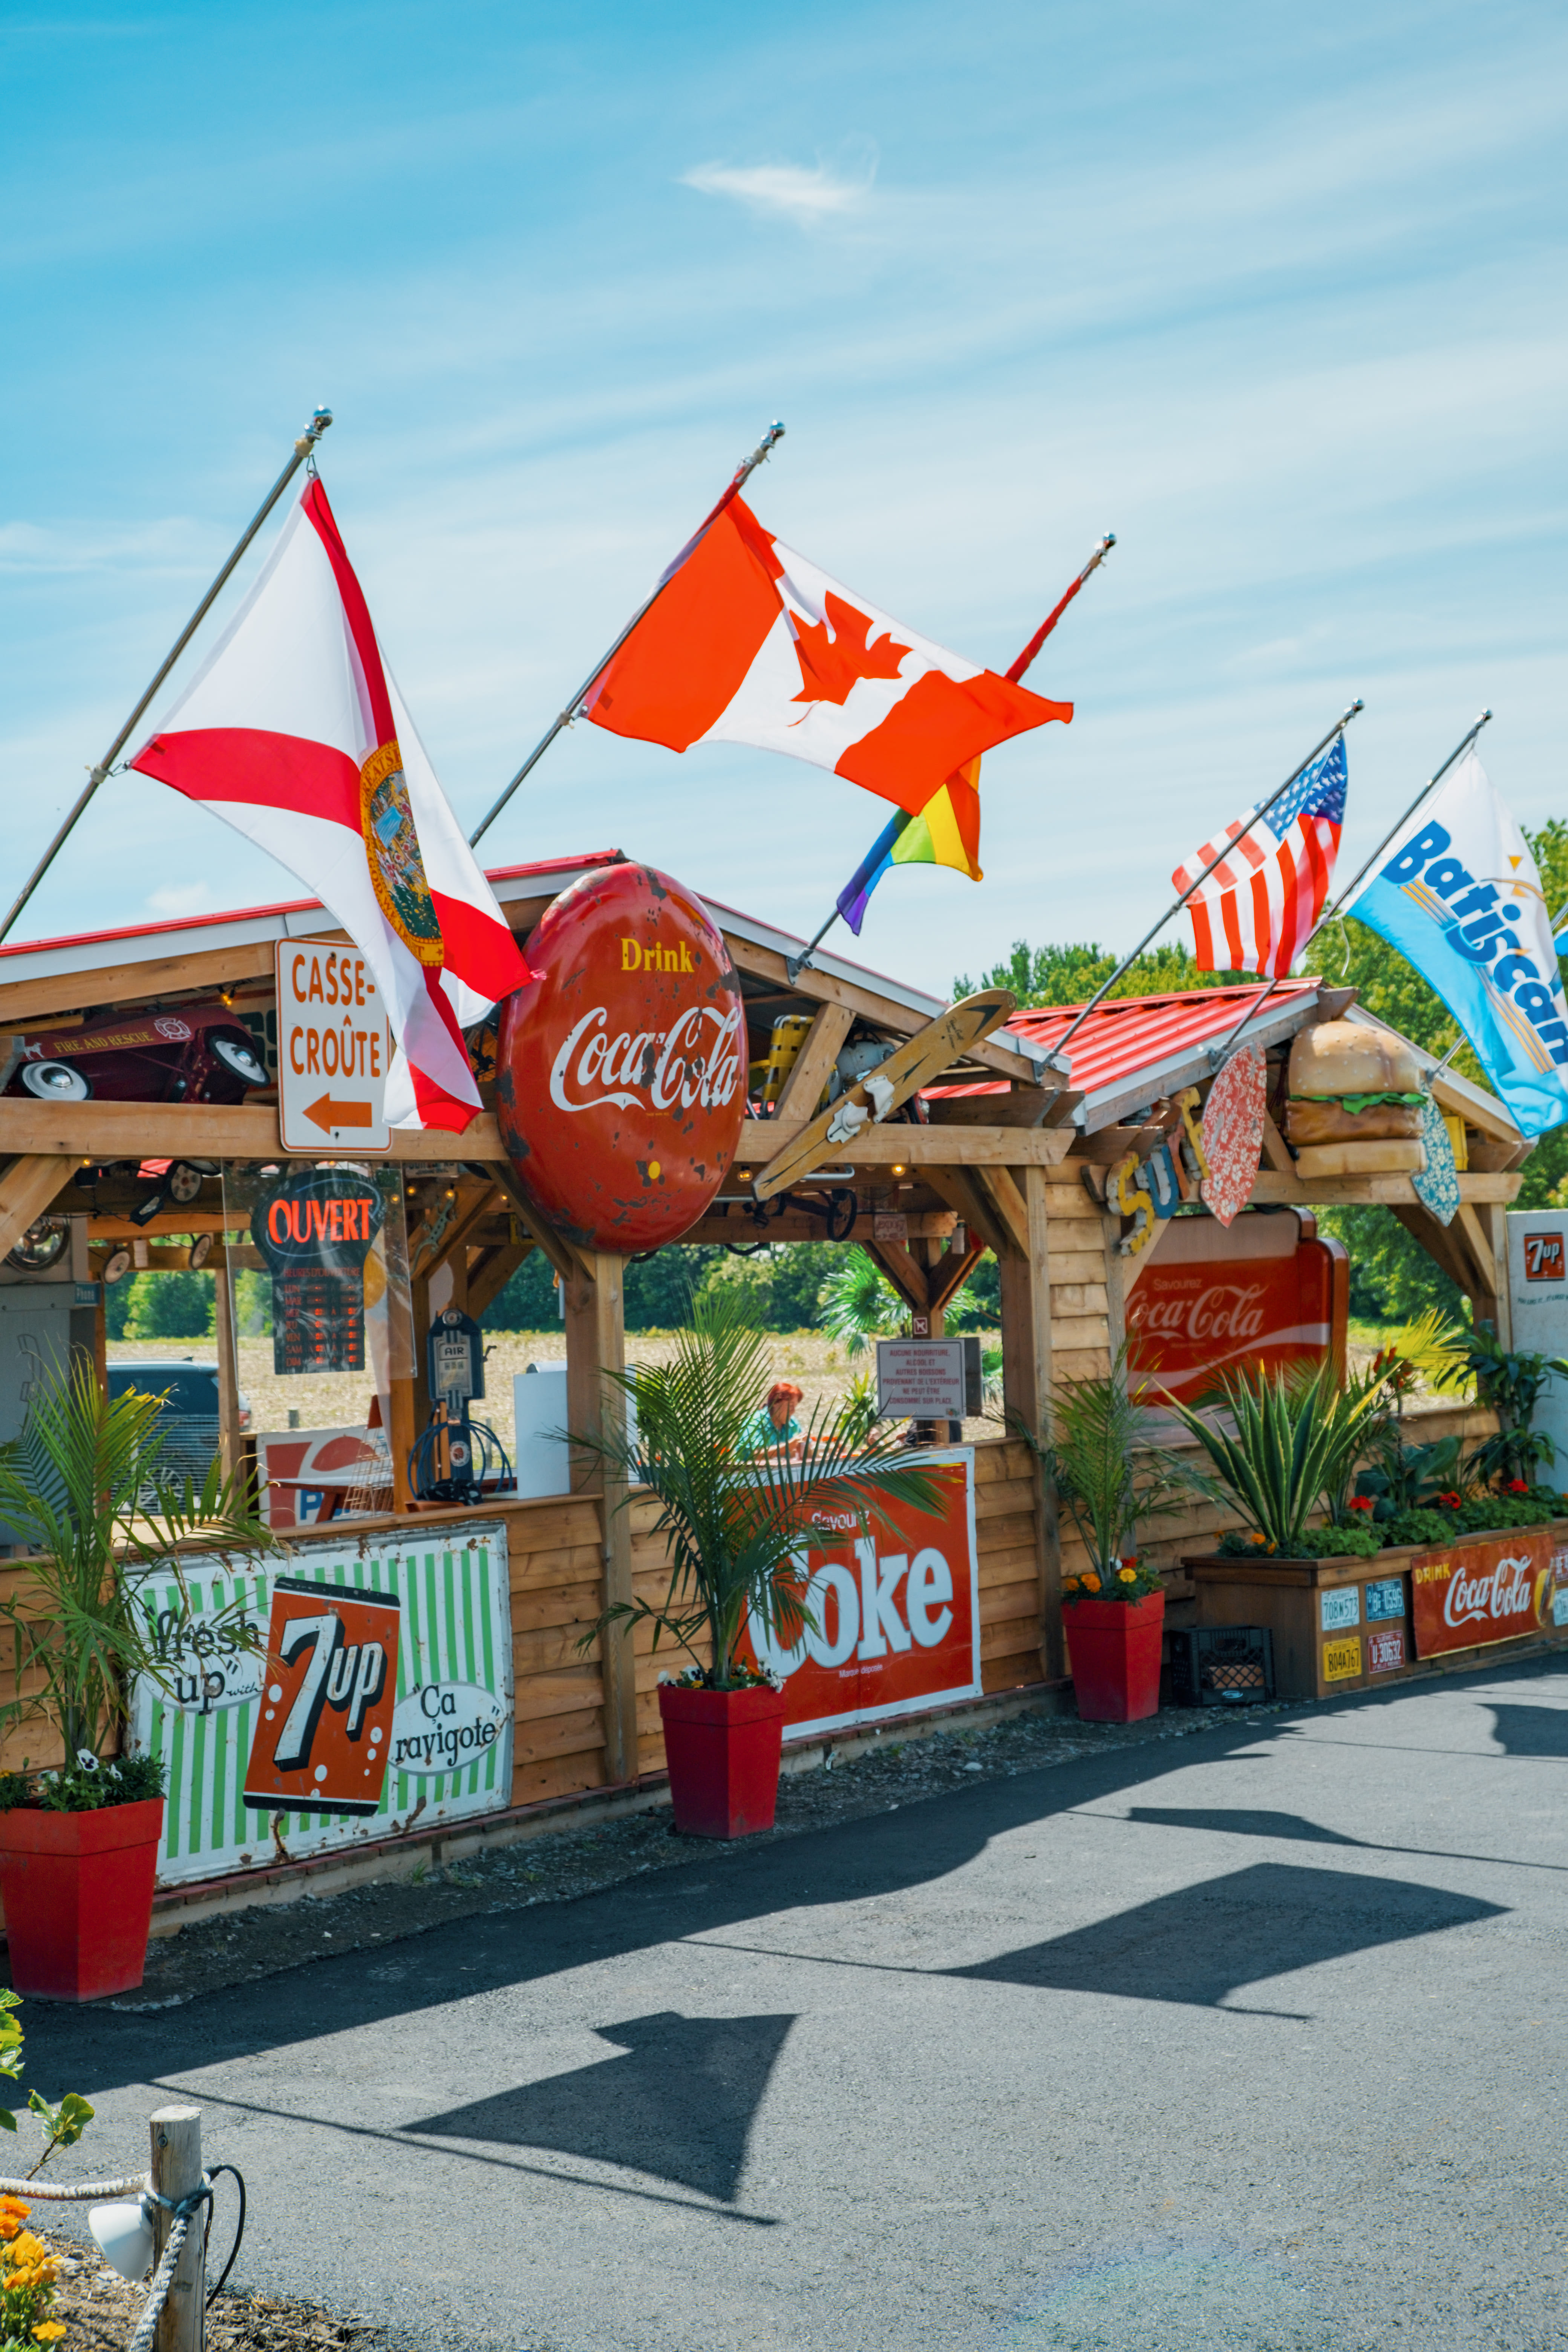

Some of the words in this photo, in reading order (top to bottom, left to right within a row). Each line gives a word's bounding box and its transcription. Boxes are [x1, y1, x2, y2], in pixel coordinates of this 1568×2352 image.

[621, 938, 694, 972] Drink
[1381, 820, 1568, 1065] Batiscan
[292, 954, 375, 1006] CASSE-
[54, 1039, 83, 1053] FIRE
[84, 1036, 107, 1049] AND
[110, 1031, 154, 1047] RESCUE
[290, 1014, 380, 1078] CROÛTE
[550, 1006, 741, 1112] Coca-Cola
[268, 1199, 373, 1243] OUVERT
[1153, 1278, 1202, 1291] Savourez
[445, 1347, 464, 1356] AIR
[1415, 1563, 1451, 1584] DRINK
[1444, 1555, 1533, 1627] Coca-Cola
[226, 1681, 264, 1696] with
[839, 1669, 859, 1678] Marque
